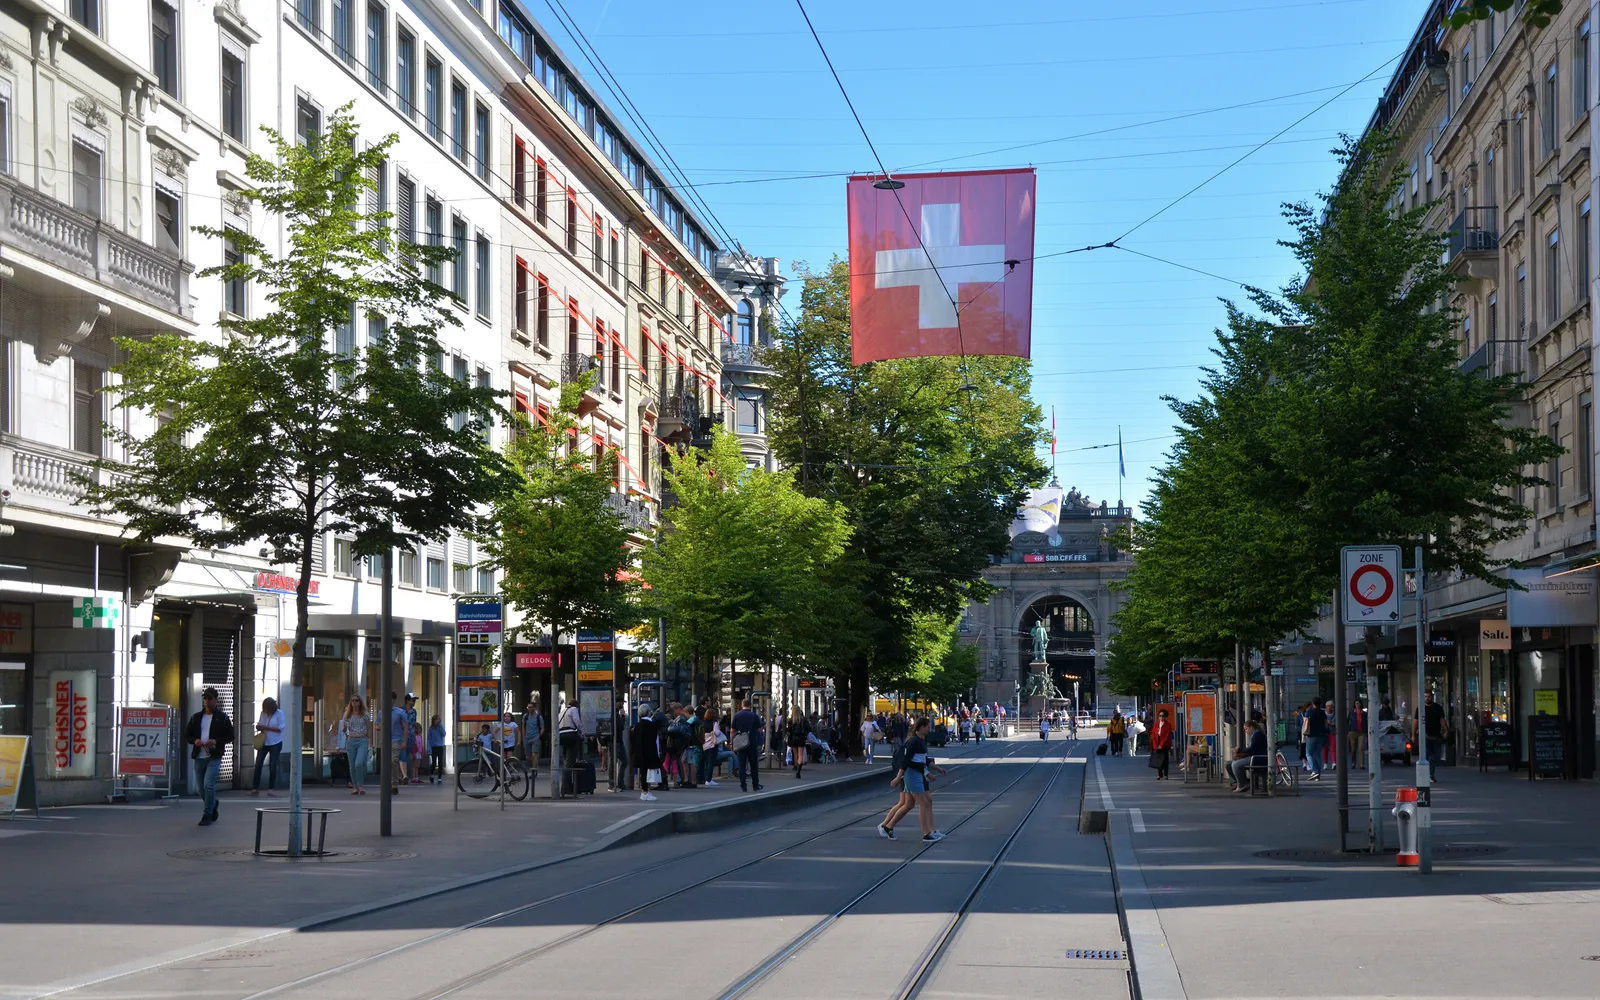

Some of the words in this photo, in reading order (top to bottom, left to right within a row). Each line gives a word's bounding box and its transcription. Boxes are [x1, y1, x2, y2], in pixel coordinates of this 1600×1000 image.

[1360, 554, 1384, 562] ZONE
[258, 572, 294, 591] OCHSNER
[1482, 630, 1509, 640] Salt.
[55, 680, 69, 768] OCHSNER
[74, 693, 87, 754] SPORT
[126, 733, 160, 748] 20%
